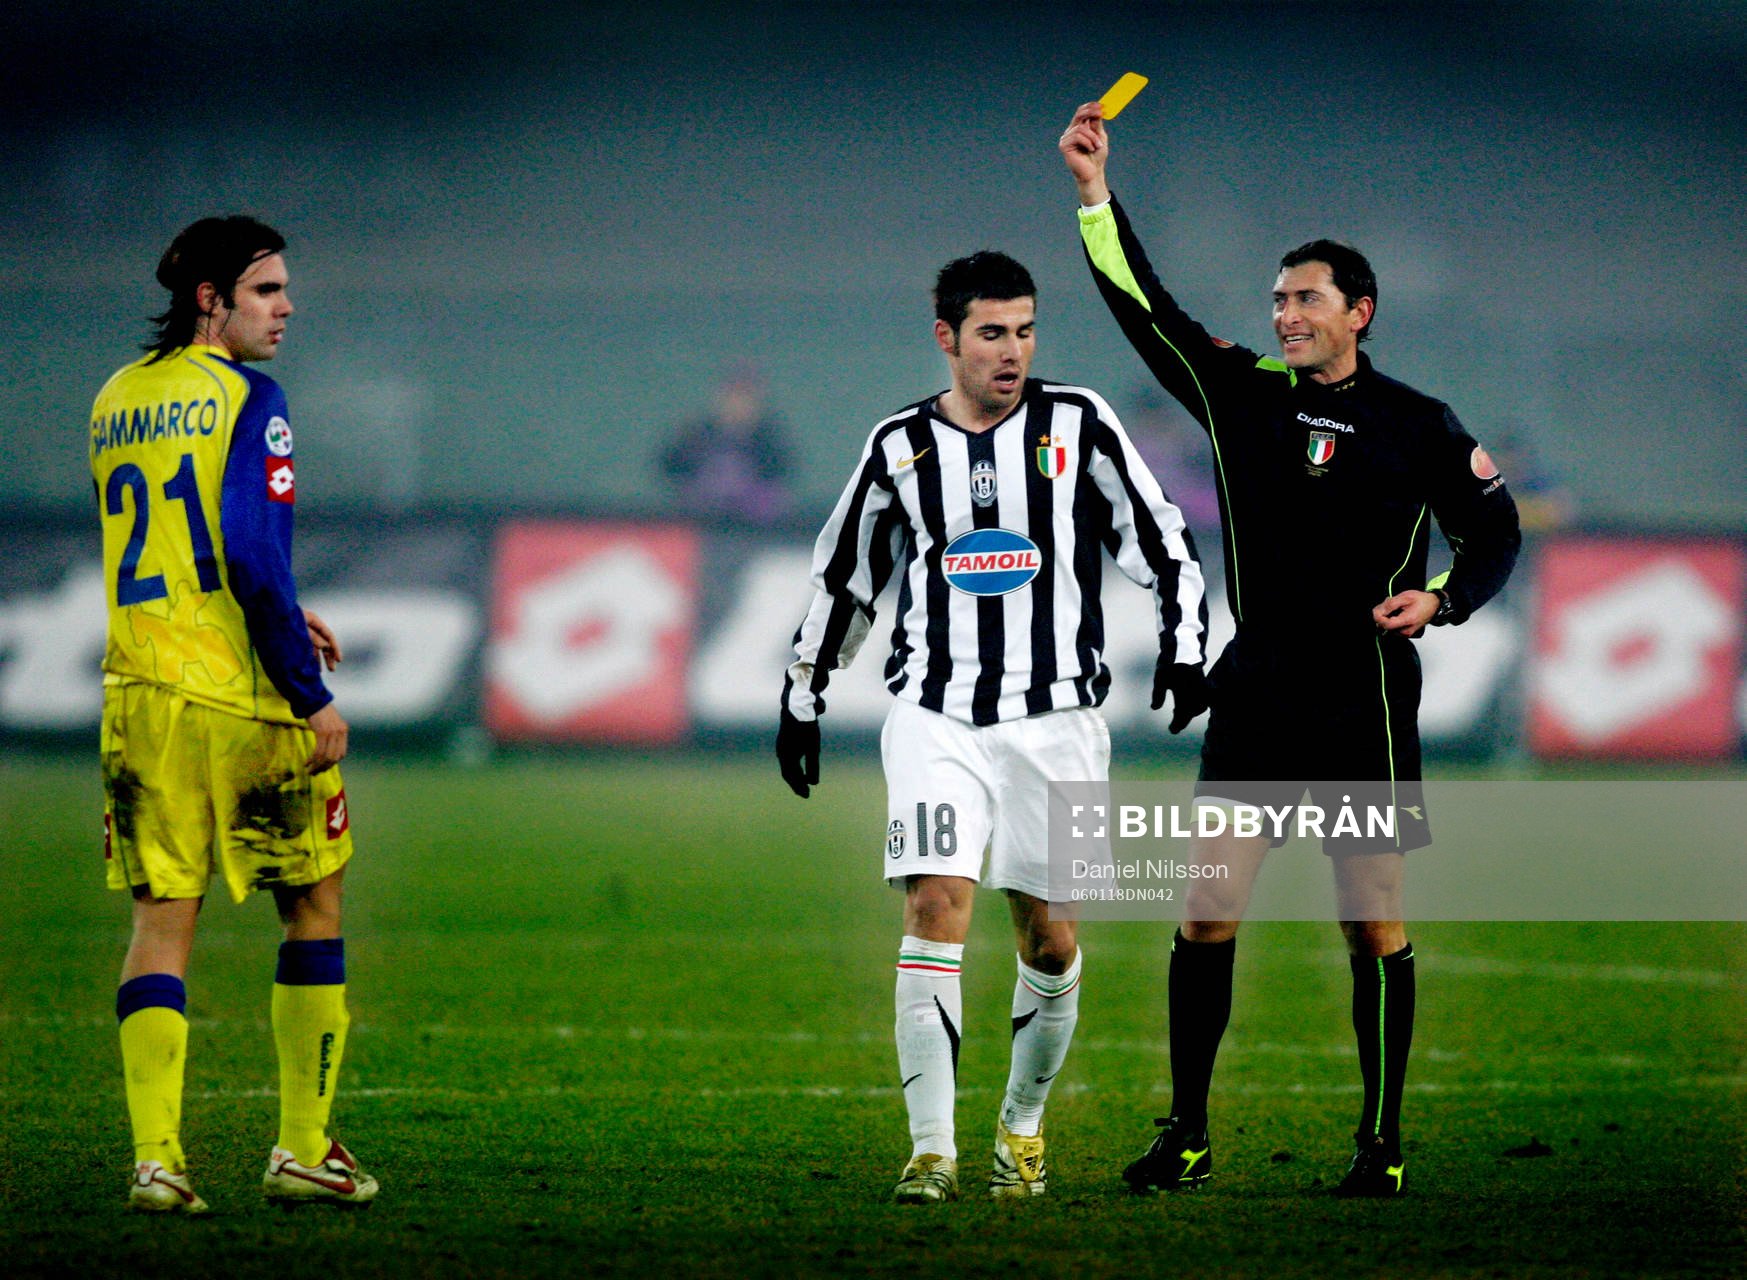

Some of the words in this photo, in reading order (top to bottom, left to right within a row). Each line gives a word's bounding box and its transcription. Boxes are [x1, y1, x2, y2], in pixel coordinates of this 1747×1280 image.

[1296, 412, 1355, 433] DIADORA
[105, 453, 222, 607] 21
[944, 552, 1039, 573] TAMOIL
[916, 802, 957, 857] 18
